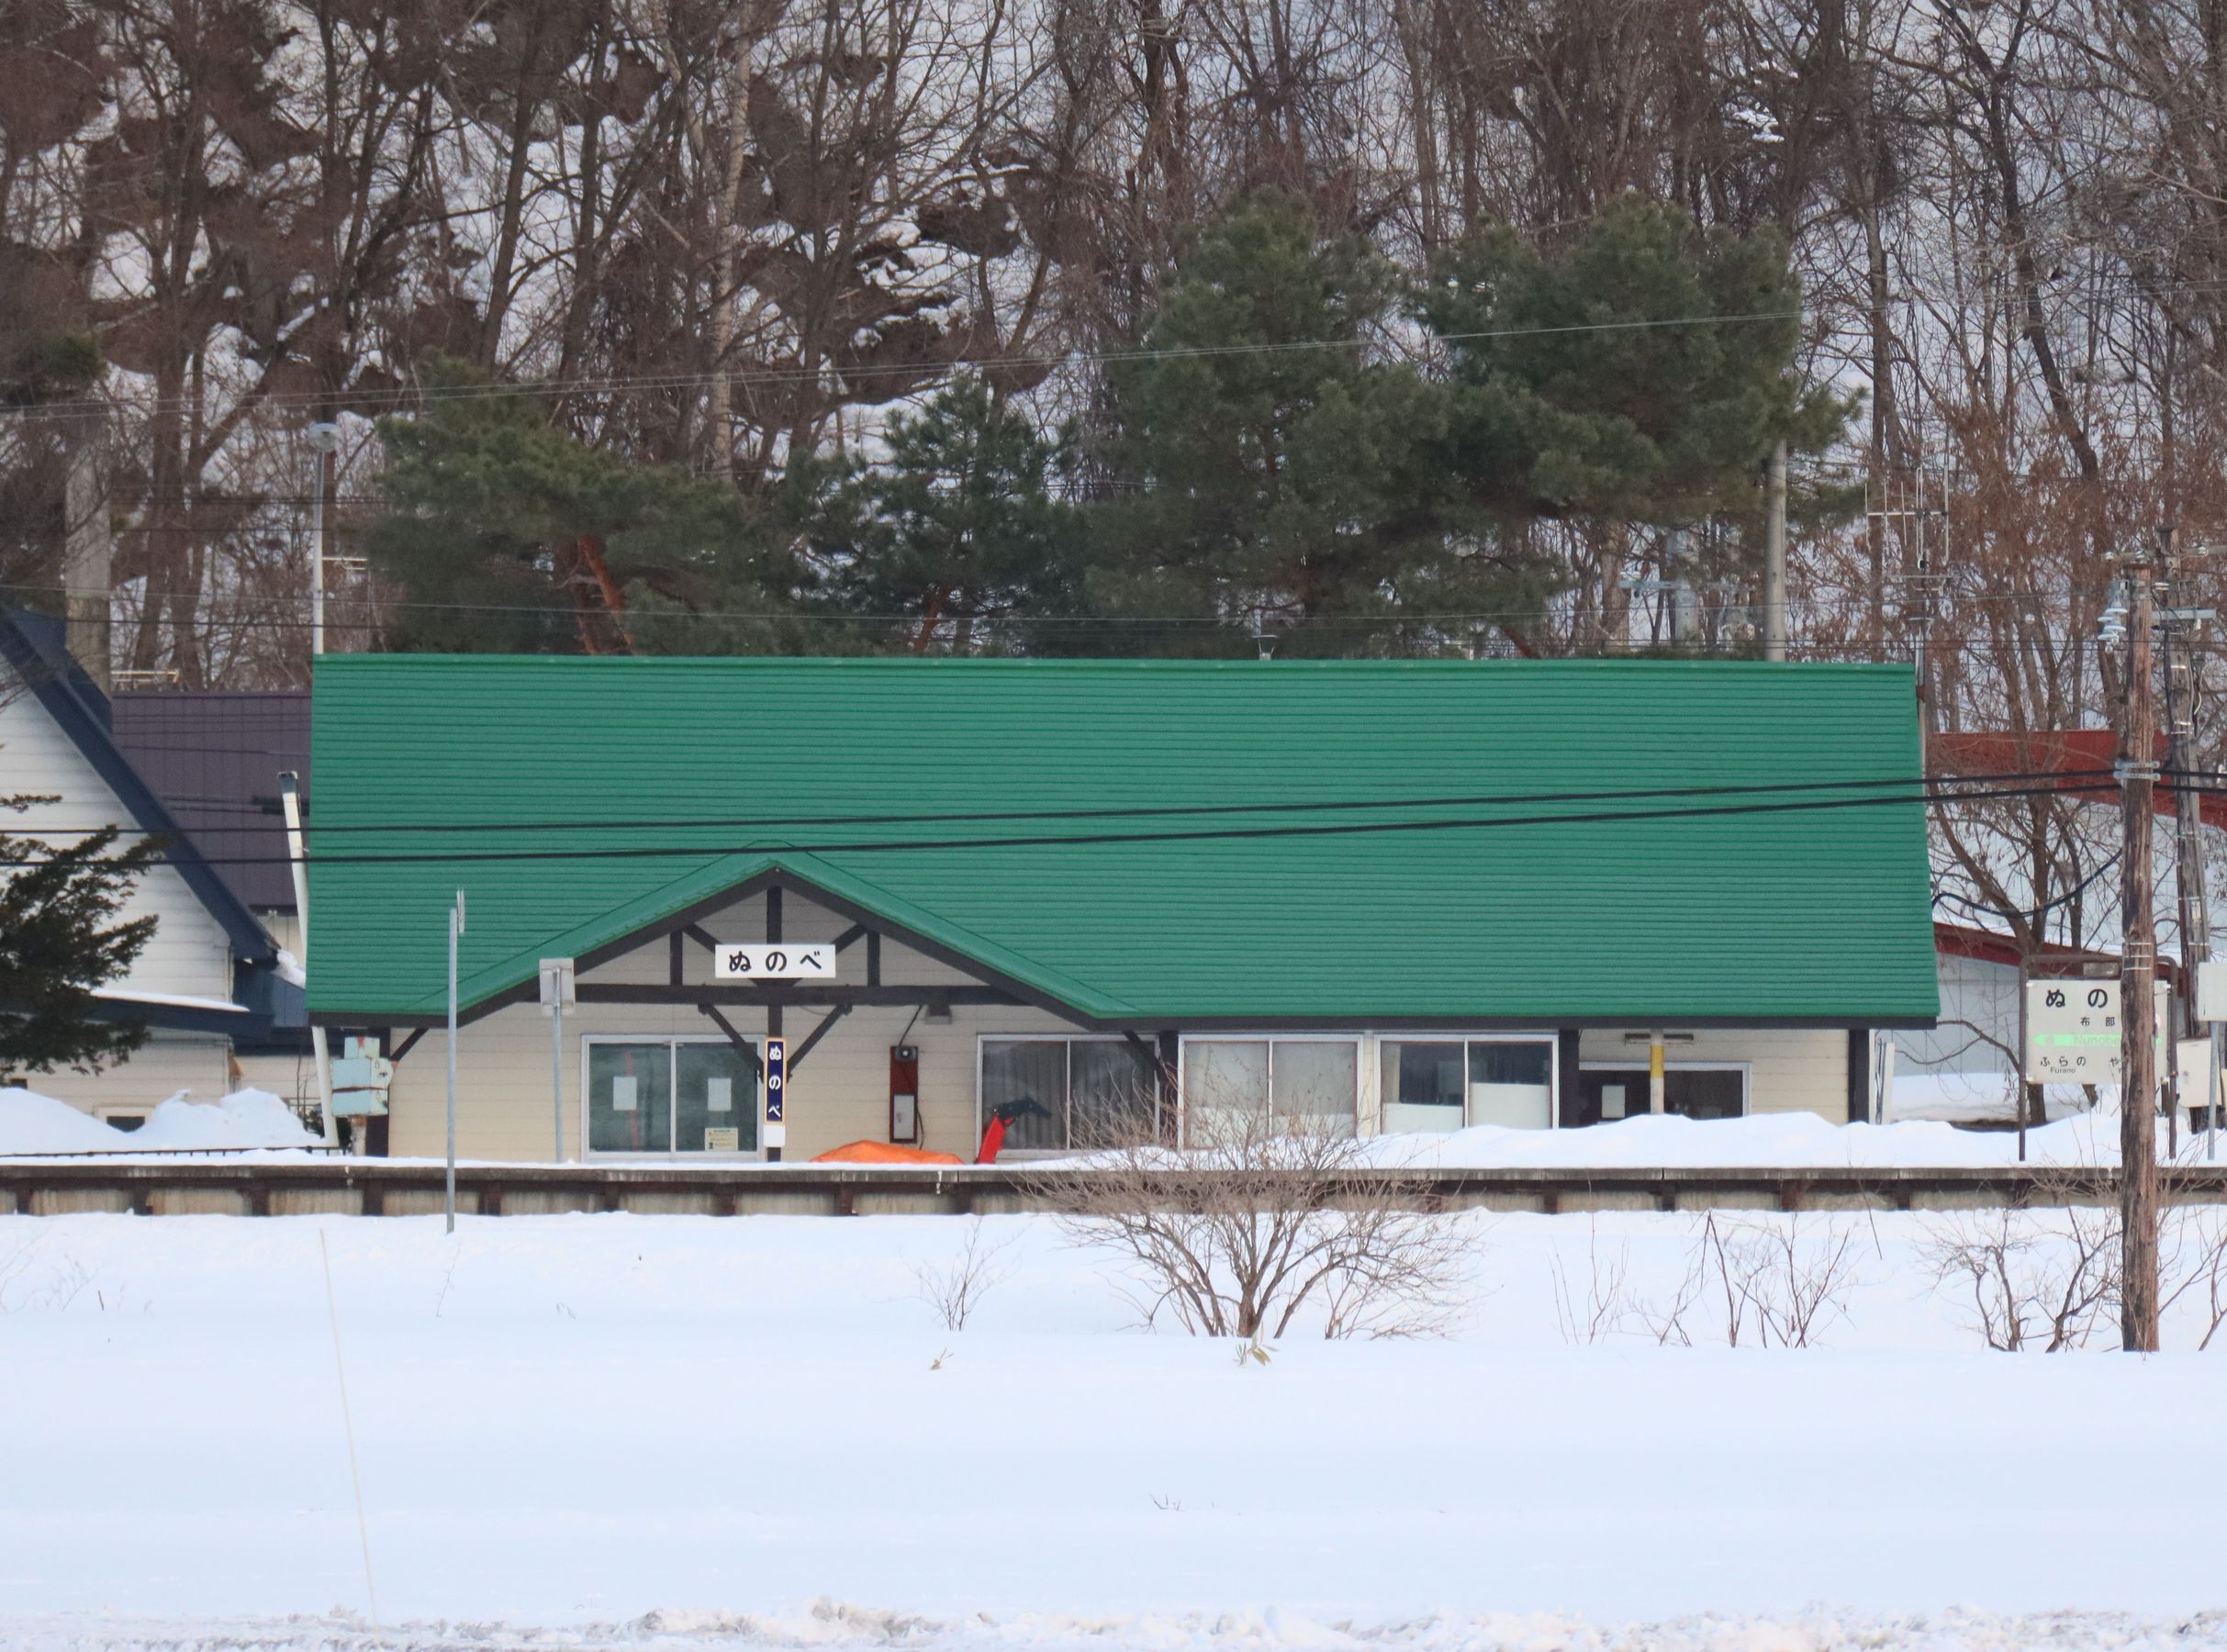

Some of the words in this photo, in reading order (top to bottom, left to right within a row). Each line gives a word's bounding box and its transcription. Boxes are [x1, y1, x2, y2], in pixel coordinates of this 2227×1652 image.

[729, 950, 823, 973] ぬのべ
[2045, 988, 2109, 1009] ぬの
[2080, 1016, 2115, 1027] 布部
[2040, 1055, 2087, 1066] ふらの
[768, 1045, 782, 1118] ぬのべ
